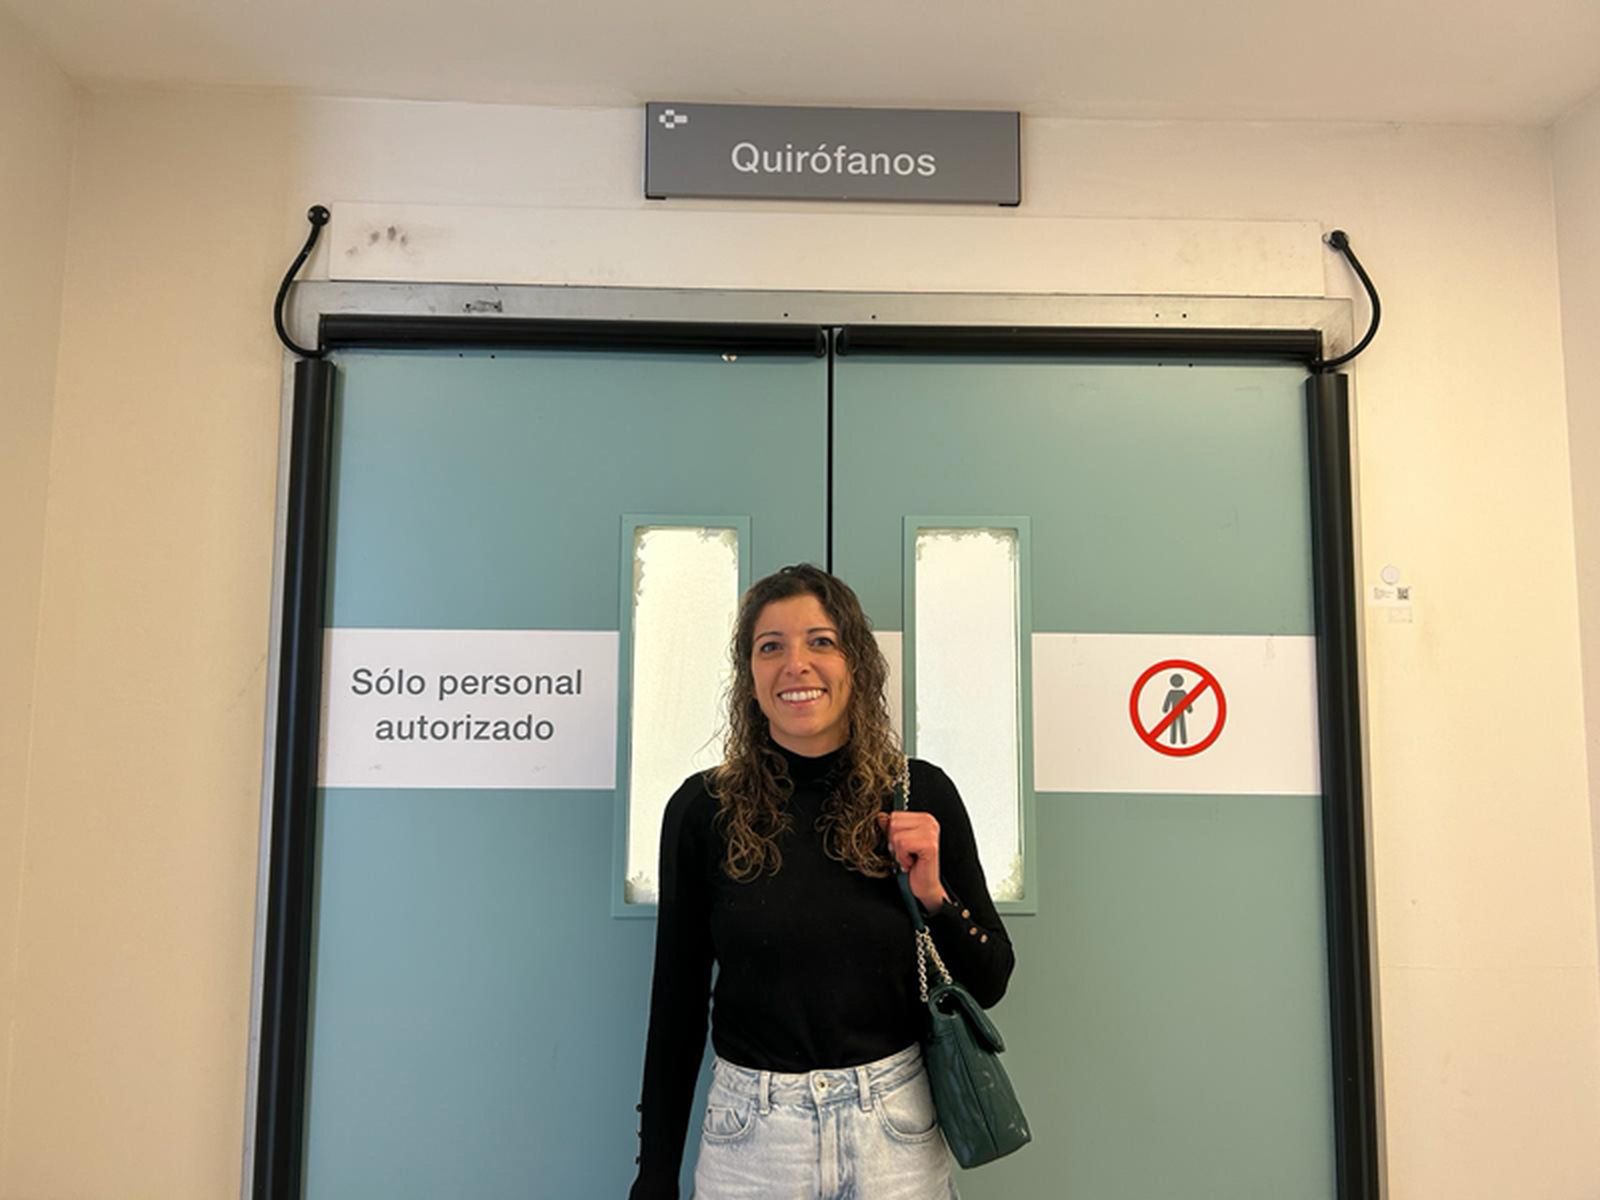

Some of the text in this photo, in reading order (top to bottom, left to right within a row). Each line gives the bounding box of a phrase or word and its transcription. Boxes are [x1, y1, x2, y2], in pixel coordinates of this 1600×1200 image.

[731, 142, 936, 177] Quirófanos
[351, 667, 582, 701] Sólo personal
[375, 714, 554, 741] autorizado
